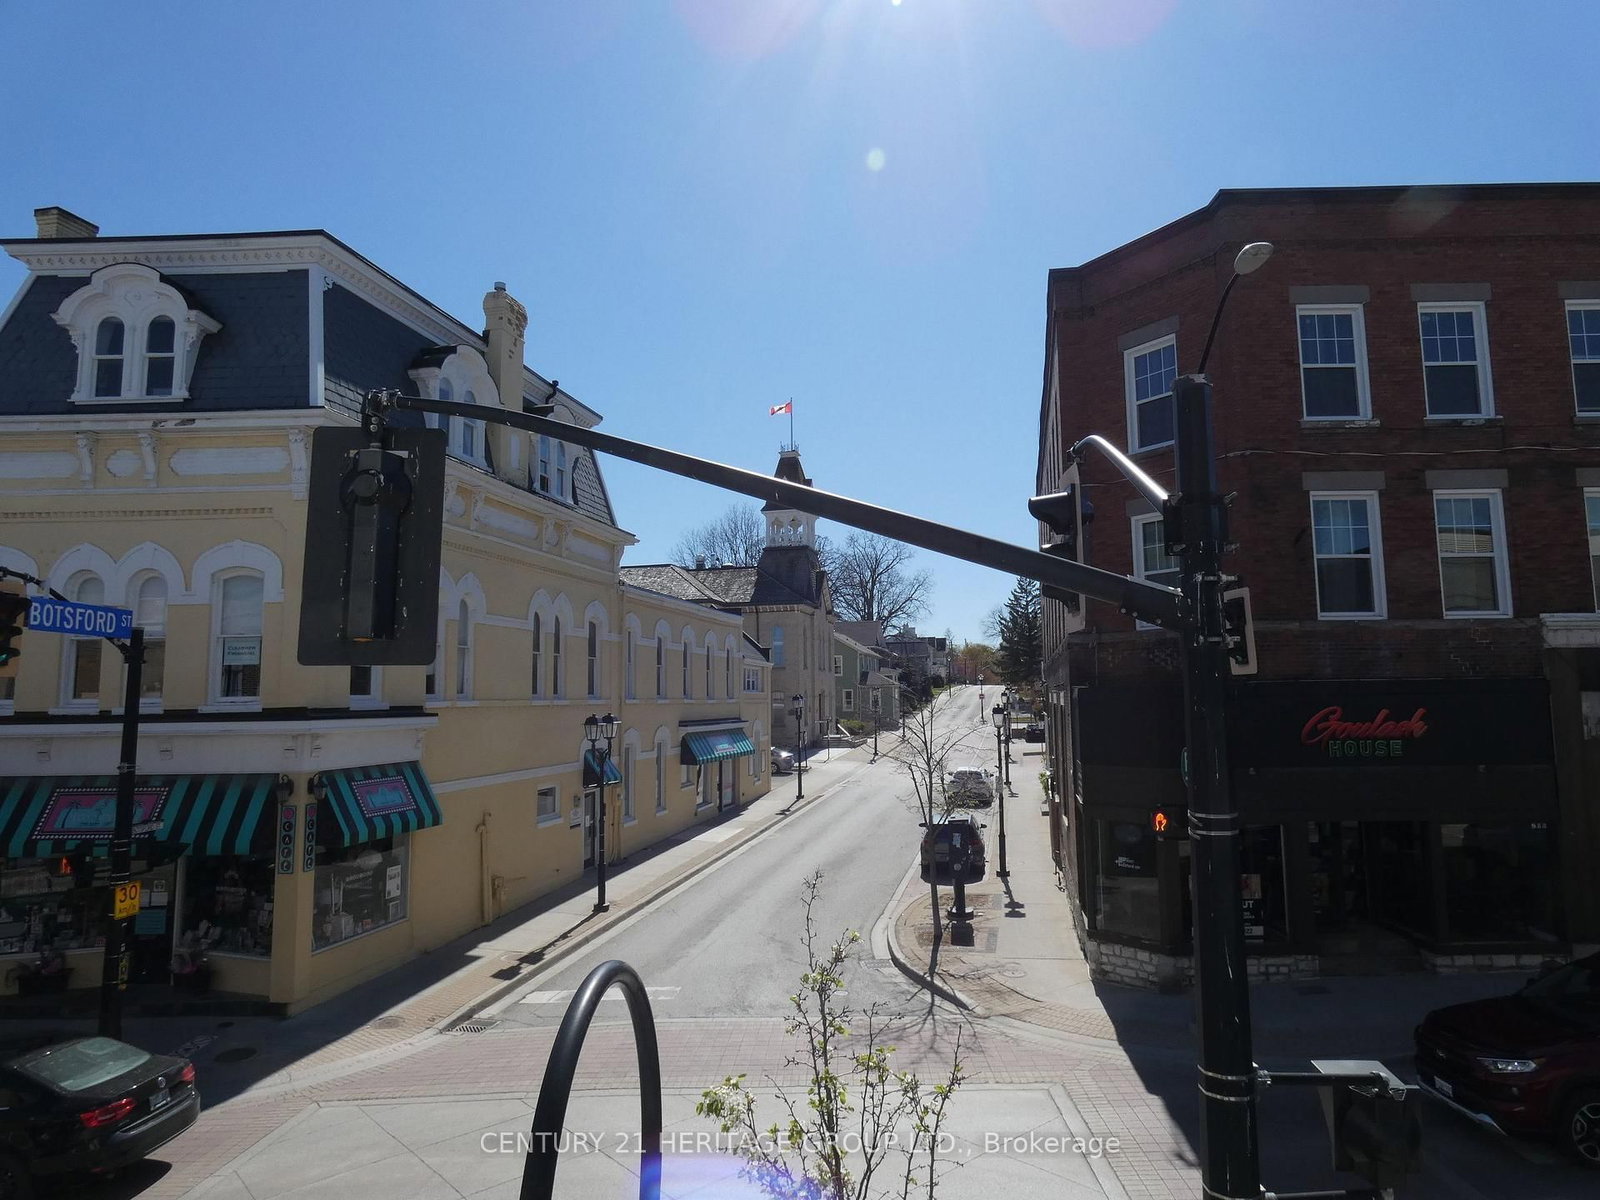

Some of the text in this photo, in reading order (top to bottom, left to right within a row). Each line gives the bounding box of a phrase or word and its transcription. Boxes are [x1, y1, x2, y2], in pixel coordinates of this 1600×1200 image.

[30, 602, 132, 633] BOTSFORD ST
[1328, 740, 1403, 758] HOUSE
[119, 884, 138, 903] 30
